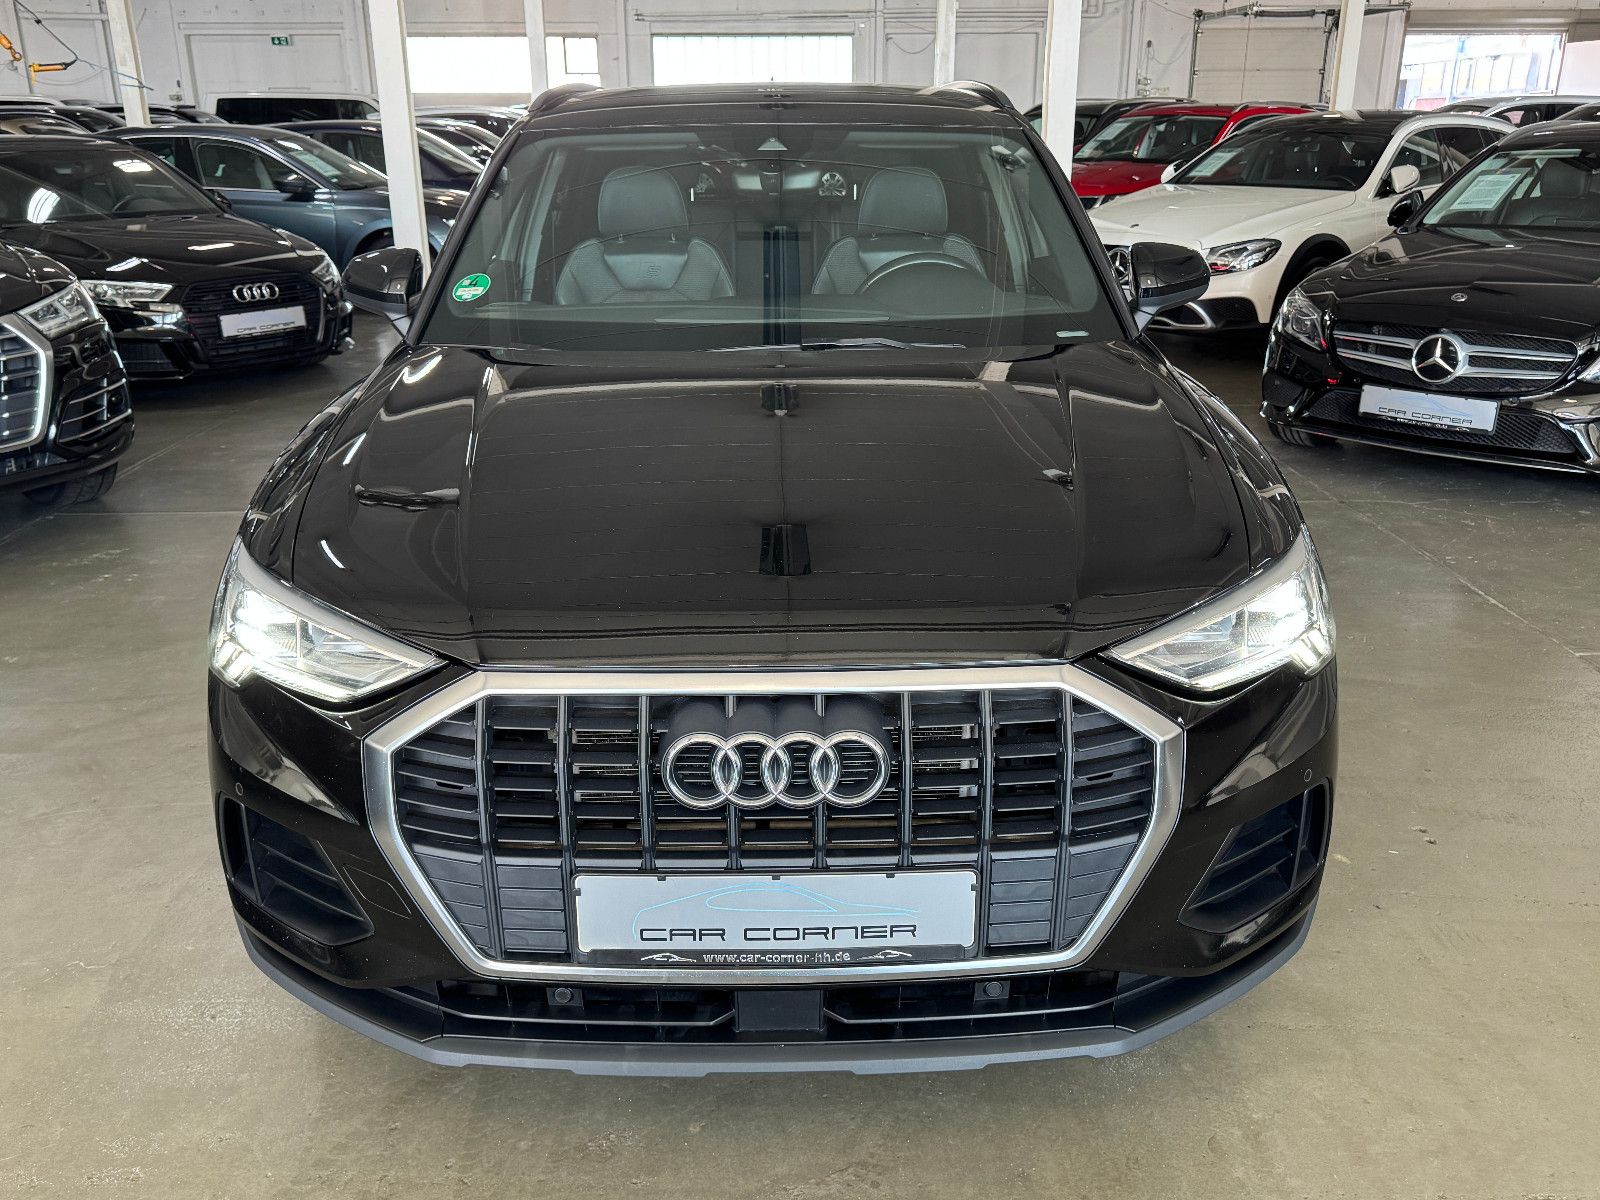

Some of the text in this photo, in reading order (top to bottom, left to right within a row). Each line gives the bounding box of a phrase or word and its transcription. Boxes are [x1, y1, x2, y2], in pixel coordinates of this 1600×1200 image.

[1378, 406, 1407, 417] CAR
[1411, 412, 1473, 426] CORNER
[639, 924, 917, 942] CAR CORNER
